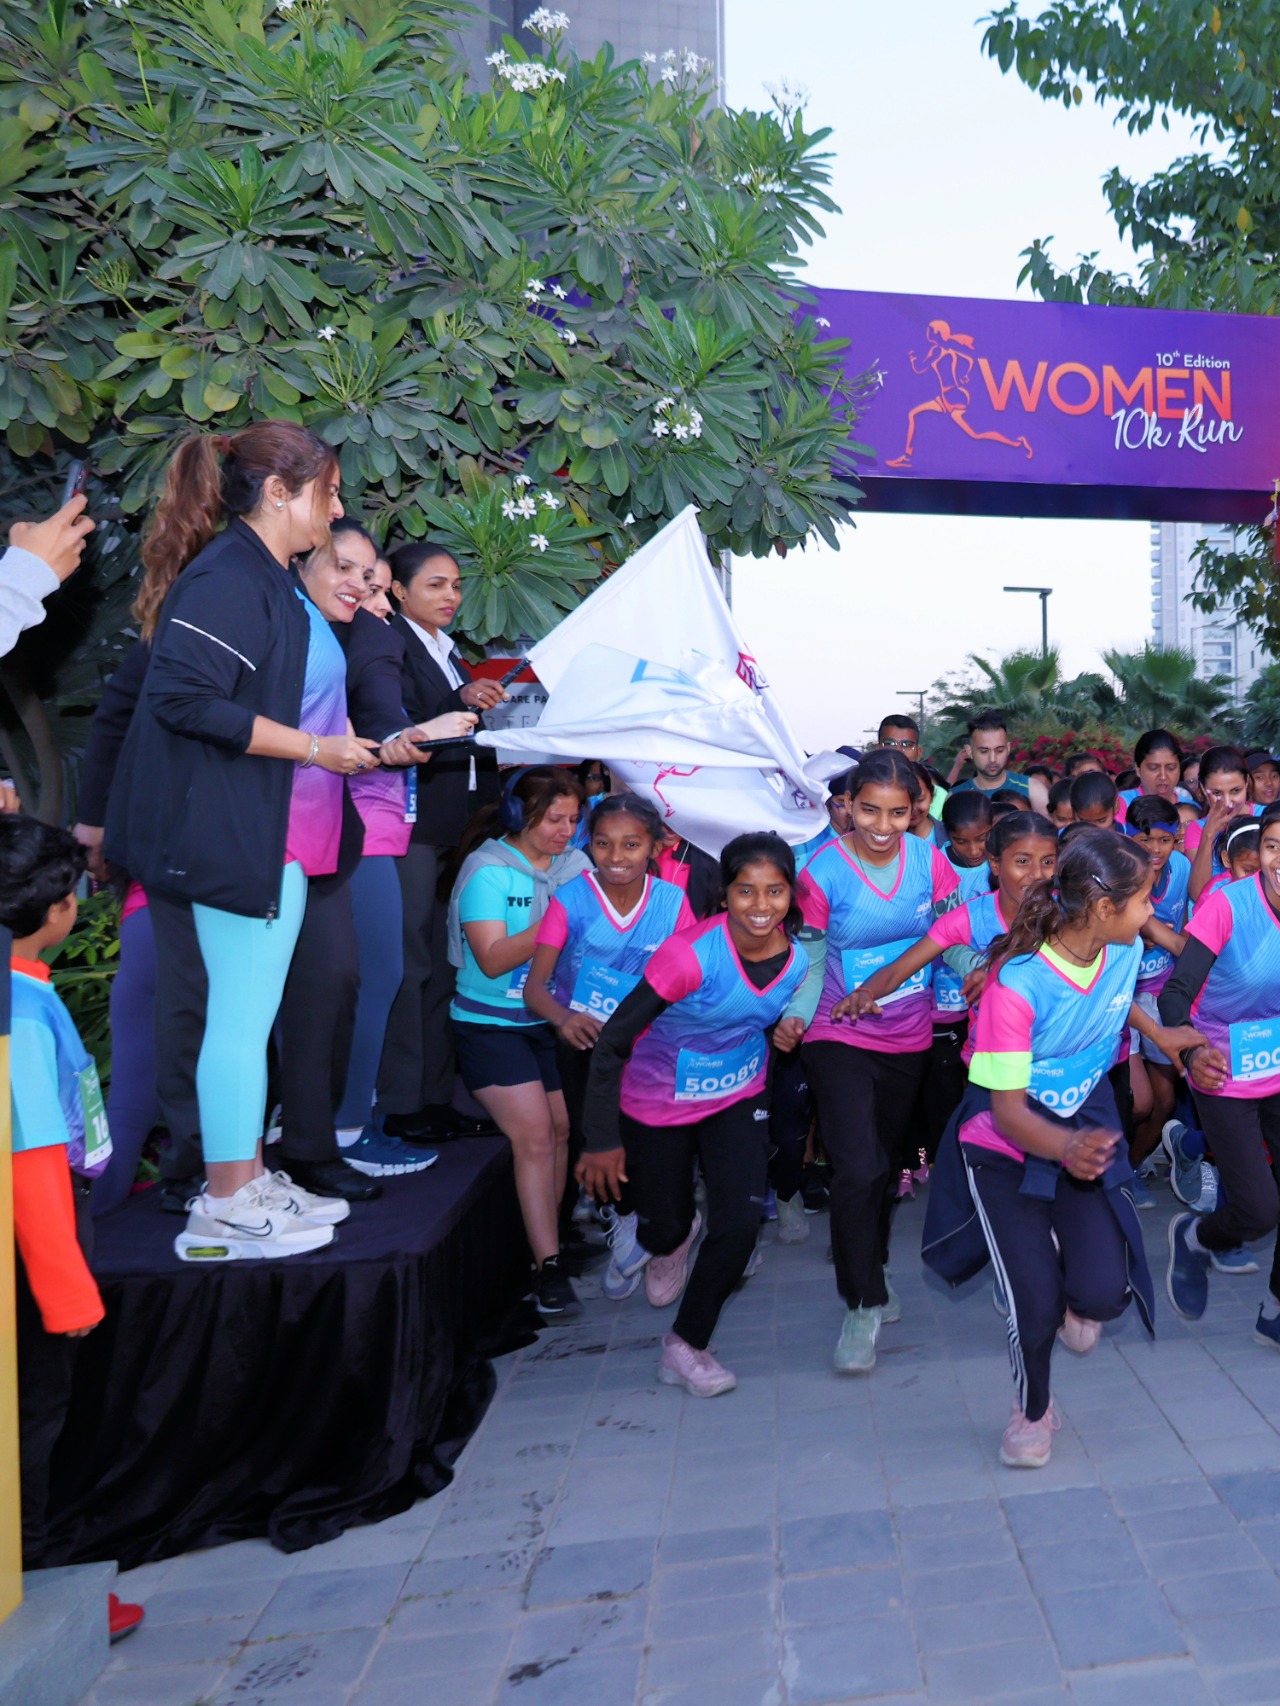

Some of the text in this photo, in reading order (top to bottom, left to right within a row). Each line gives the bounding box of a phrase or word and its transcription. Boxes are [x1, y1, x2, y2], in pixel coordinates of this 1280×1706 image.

[1183, 354, 1231, 369] Edition
[977, 358, 1232, 421] WOMEN
[1110, 403, 1244, 453] 10k Run
[684, 1056, 760, 1092] 50089
